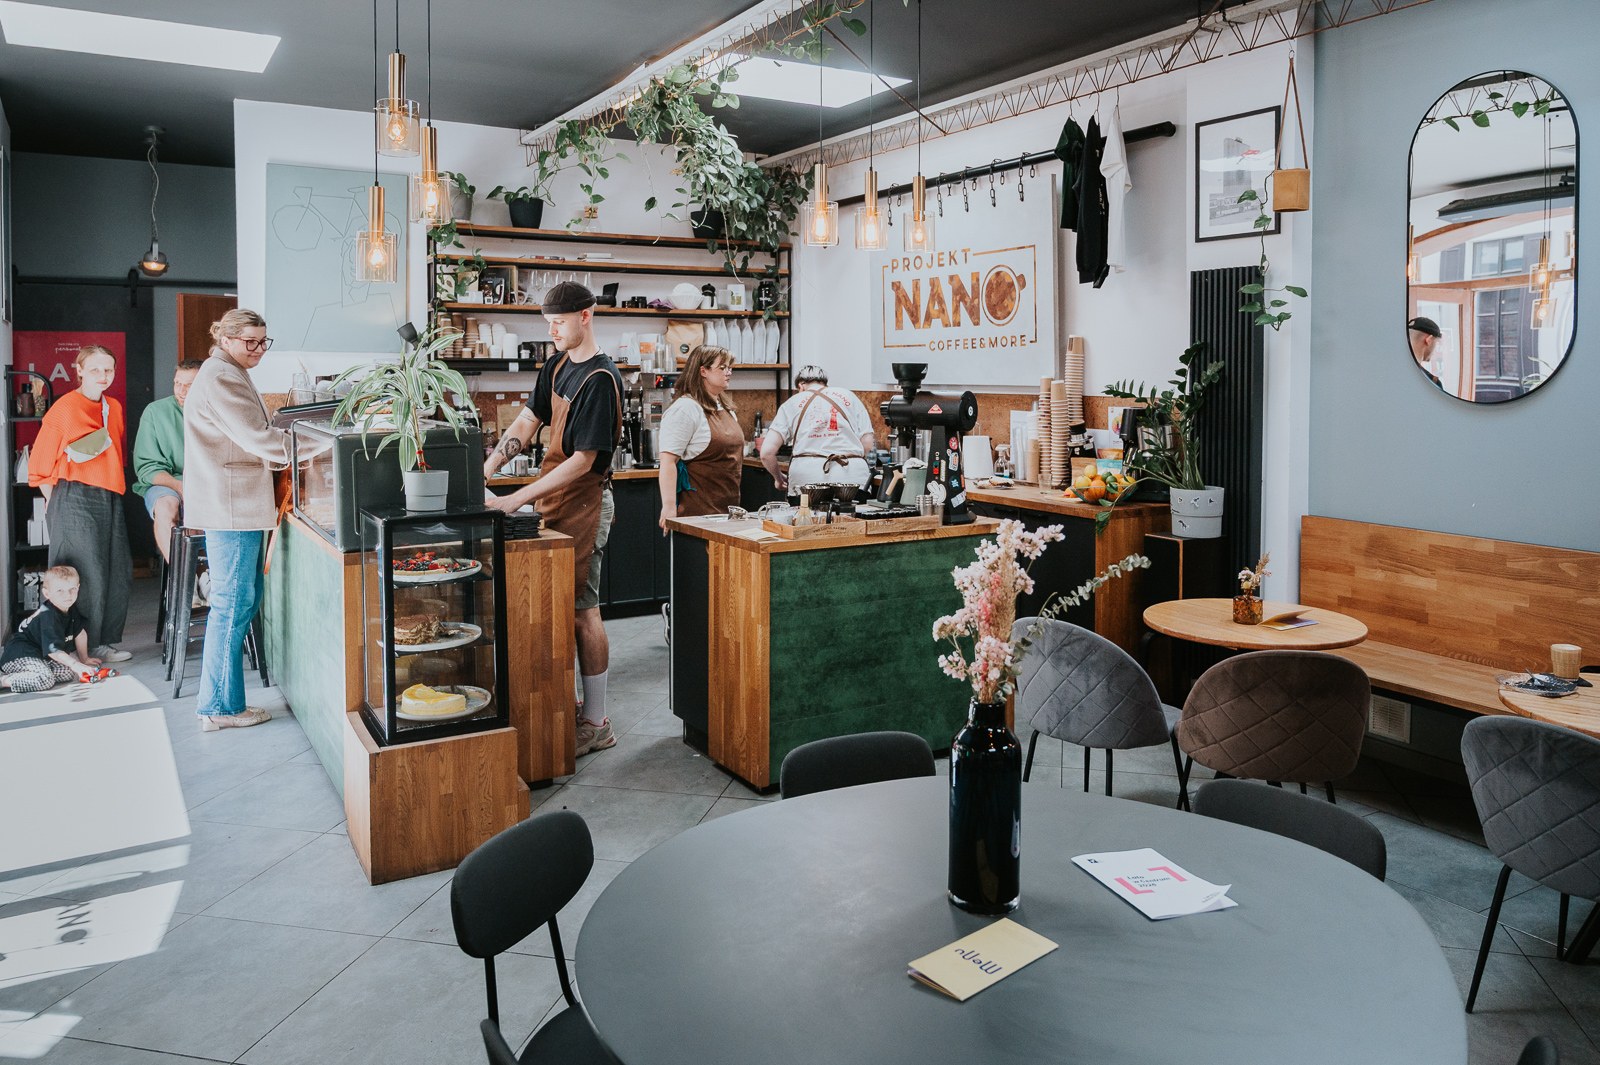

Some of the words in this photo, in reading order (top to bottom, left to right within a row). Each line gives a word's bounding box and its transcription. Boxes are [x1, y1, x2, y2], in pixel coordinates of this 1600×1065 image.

[891, 248, 970, 273] PROJEKT
[891, 265, 1026, 331] NANO
[929, 335, 1027, 352] COFFEE&MORE
